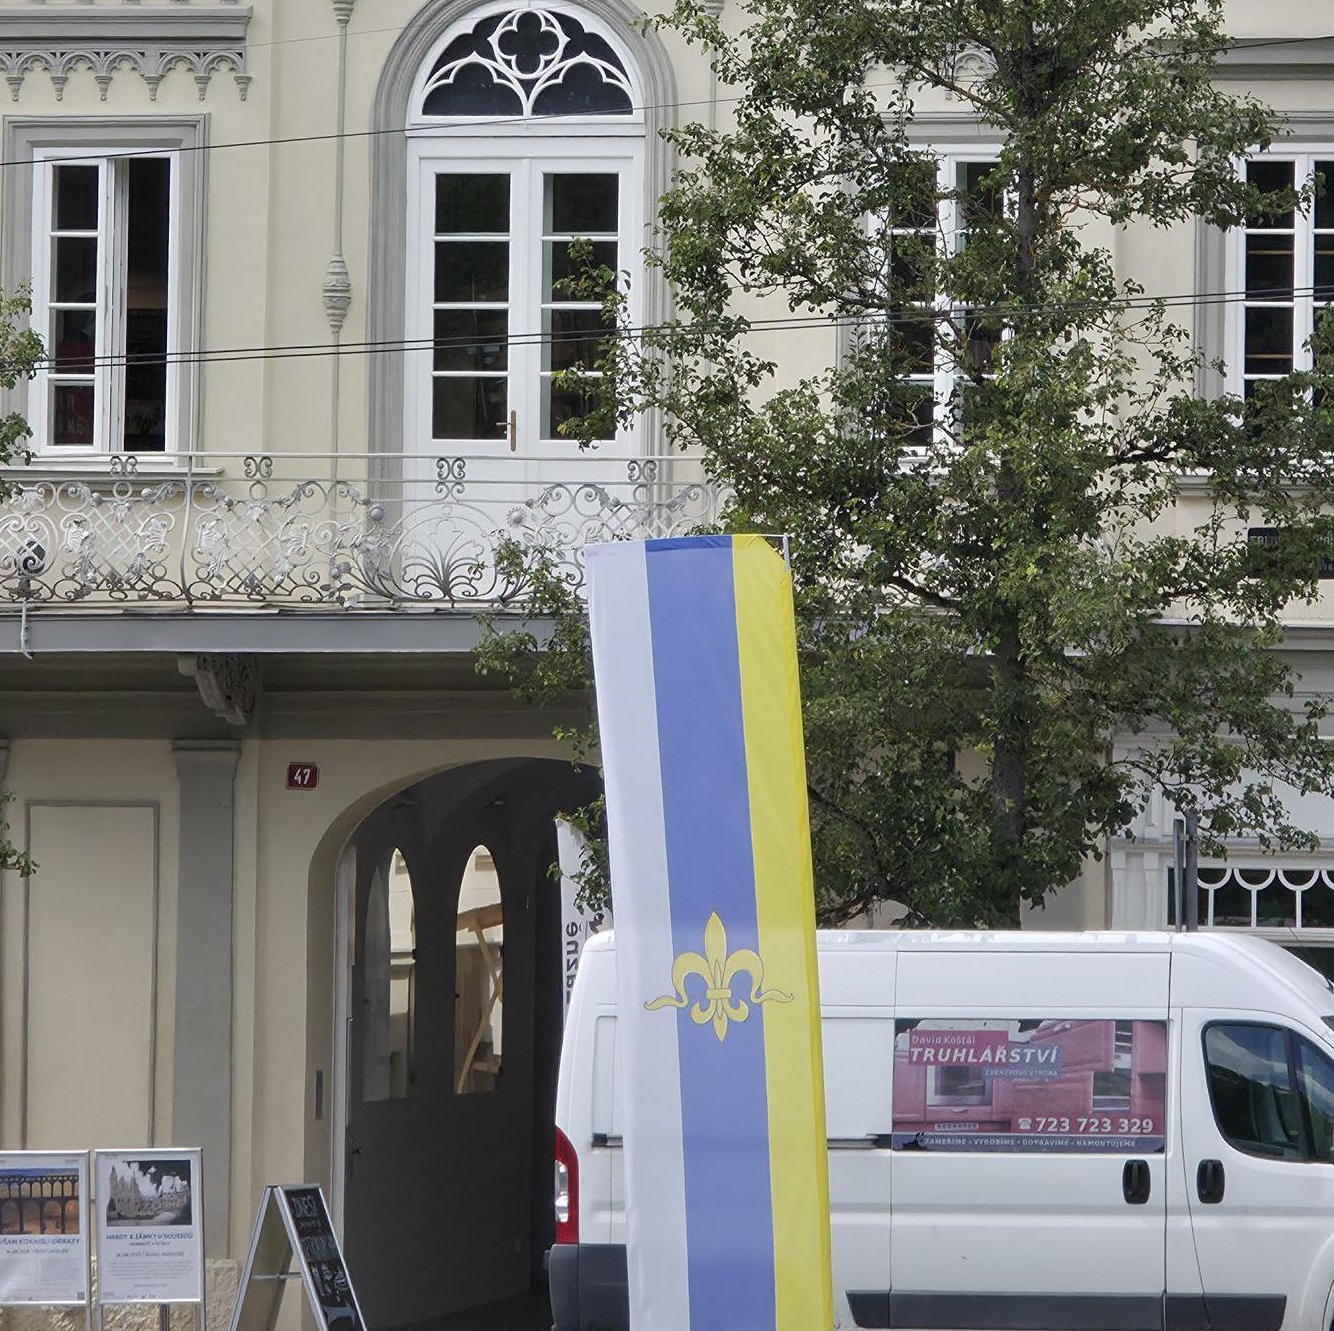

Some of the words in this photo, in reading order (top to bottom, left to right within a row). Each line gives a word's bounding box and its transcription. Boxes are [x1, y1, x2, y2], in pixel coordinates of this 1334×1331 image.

[294, 768, 311, 785] 47
[911, 1035, 942, 1044] David
[910, 1045, 1059, 1063] TRUHLÁŘSTVÍ
[1035, 1117, 1069, 1132] 723
[1077, 1117, 1112, 1133] 723
[1118, 1118, 1153, 1133] 329
